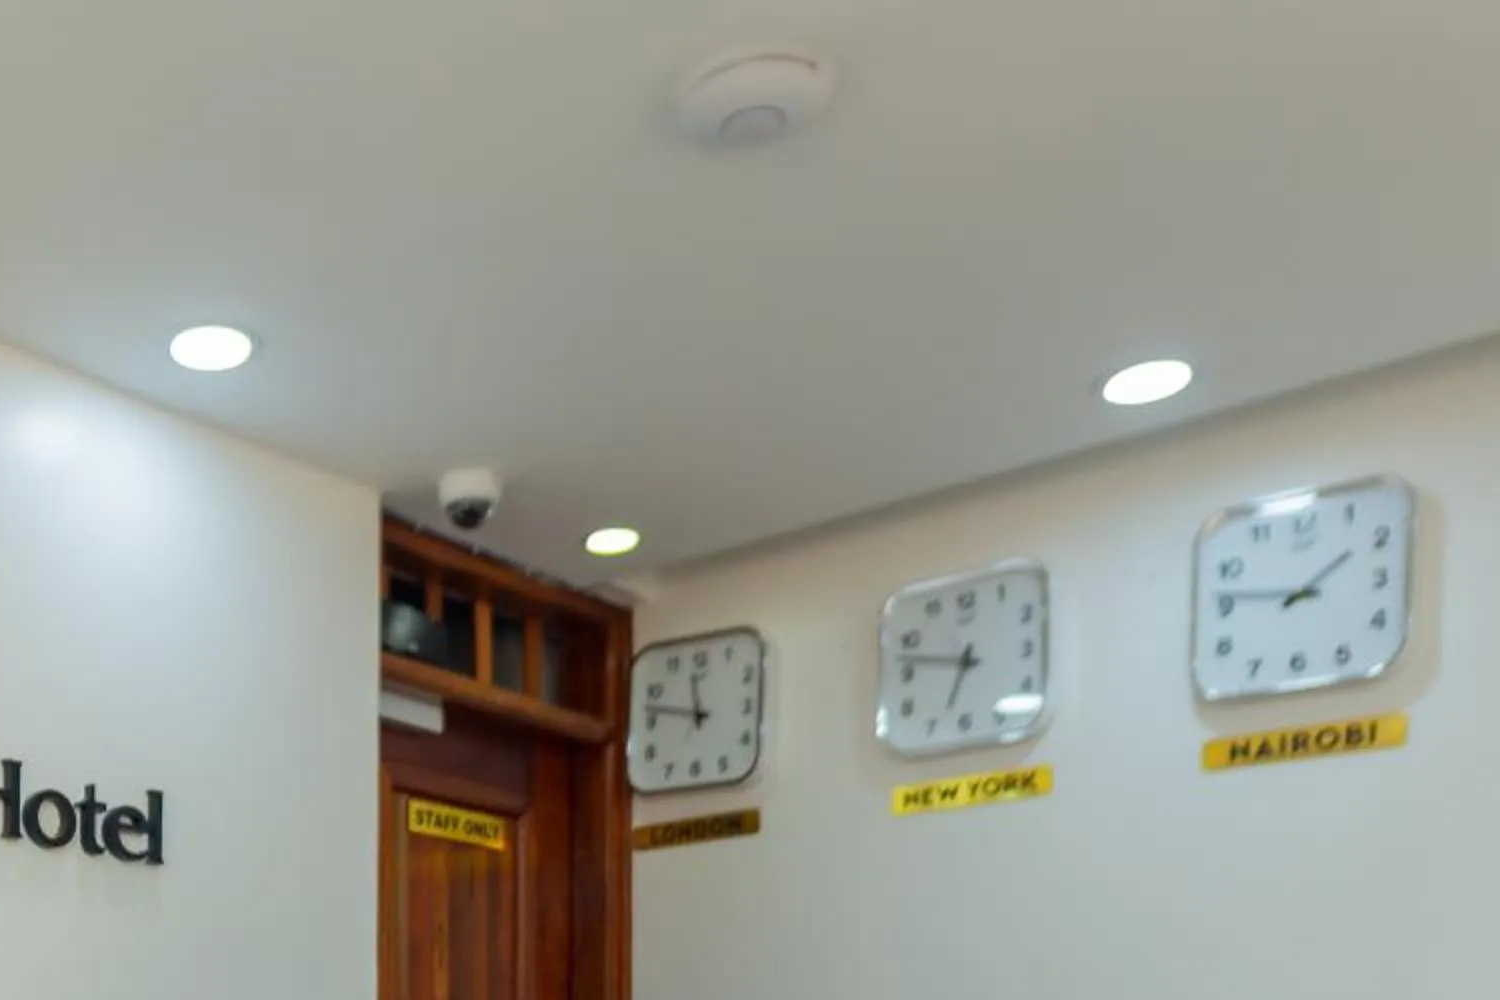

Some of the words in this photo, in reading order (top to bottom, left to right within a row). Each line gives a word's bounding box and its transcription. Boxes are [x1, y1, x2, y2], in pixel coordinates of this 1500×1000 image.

[1229, 719, 1378, 762] NAIROBI
[902, 782, 960, 809] NEW
[970, 768, 1038, 798] YORK
[415, 808, 460, 833] STAFF
[463, 818, 499, 840] ONLY
